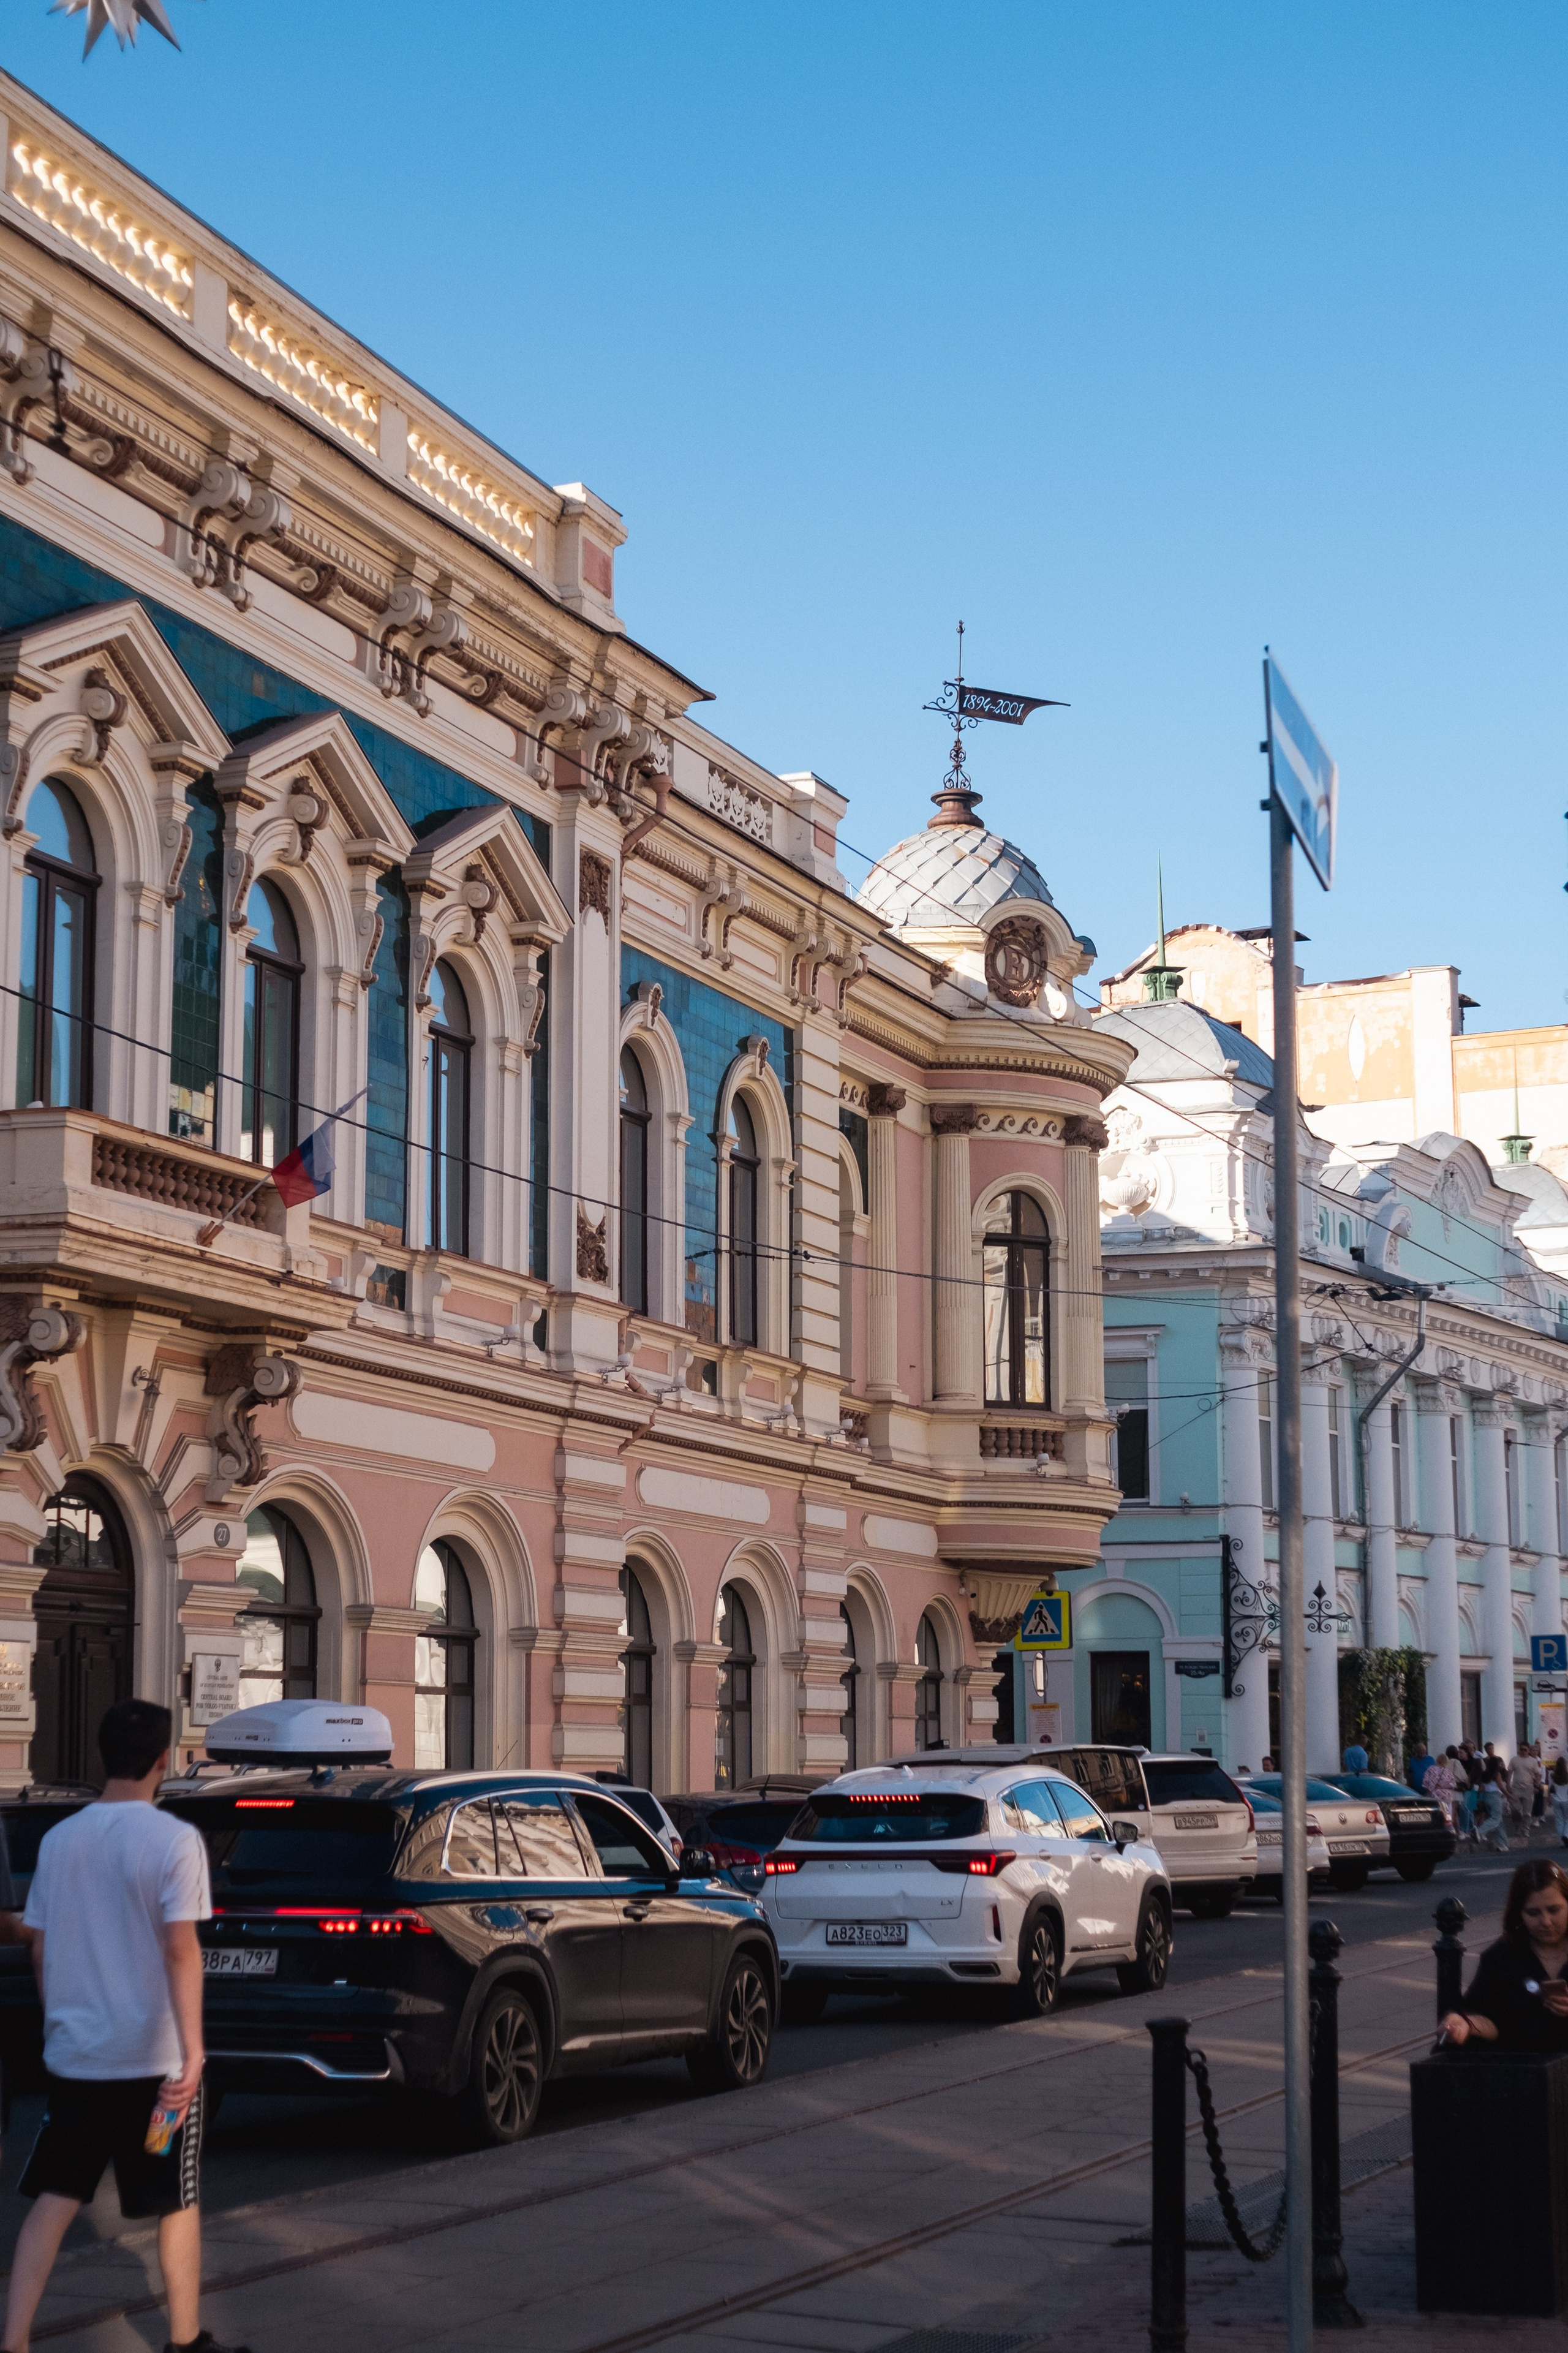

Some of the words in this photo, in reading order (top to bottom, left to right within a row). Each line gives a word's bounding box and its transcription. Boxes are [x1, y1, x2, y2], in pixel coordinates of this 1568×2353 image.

[962, 693, 1025, 717] 1894-2001
[217, 1528, 227, 1541] 27
[1539, 1639, 1558, 1667] P
[831, 1926, 881, 1941] А823ЕО
[883, 1926, 902, 1937] 323
[246, 1951, 272, 1966] 797
